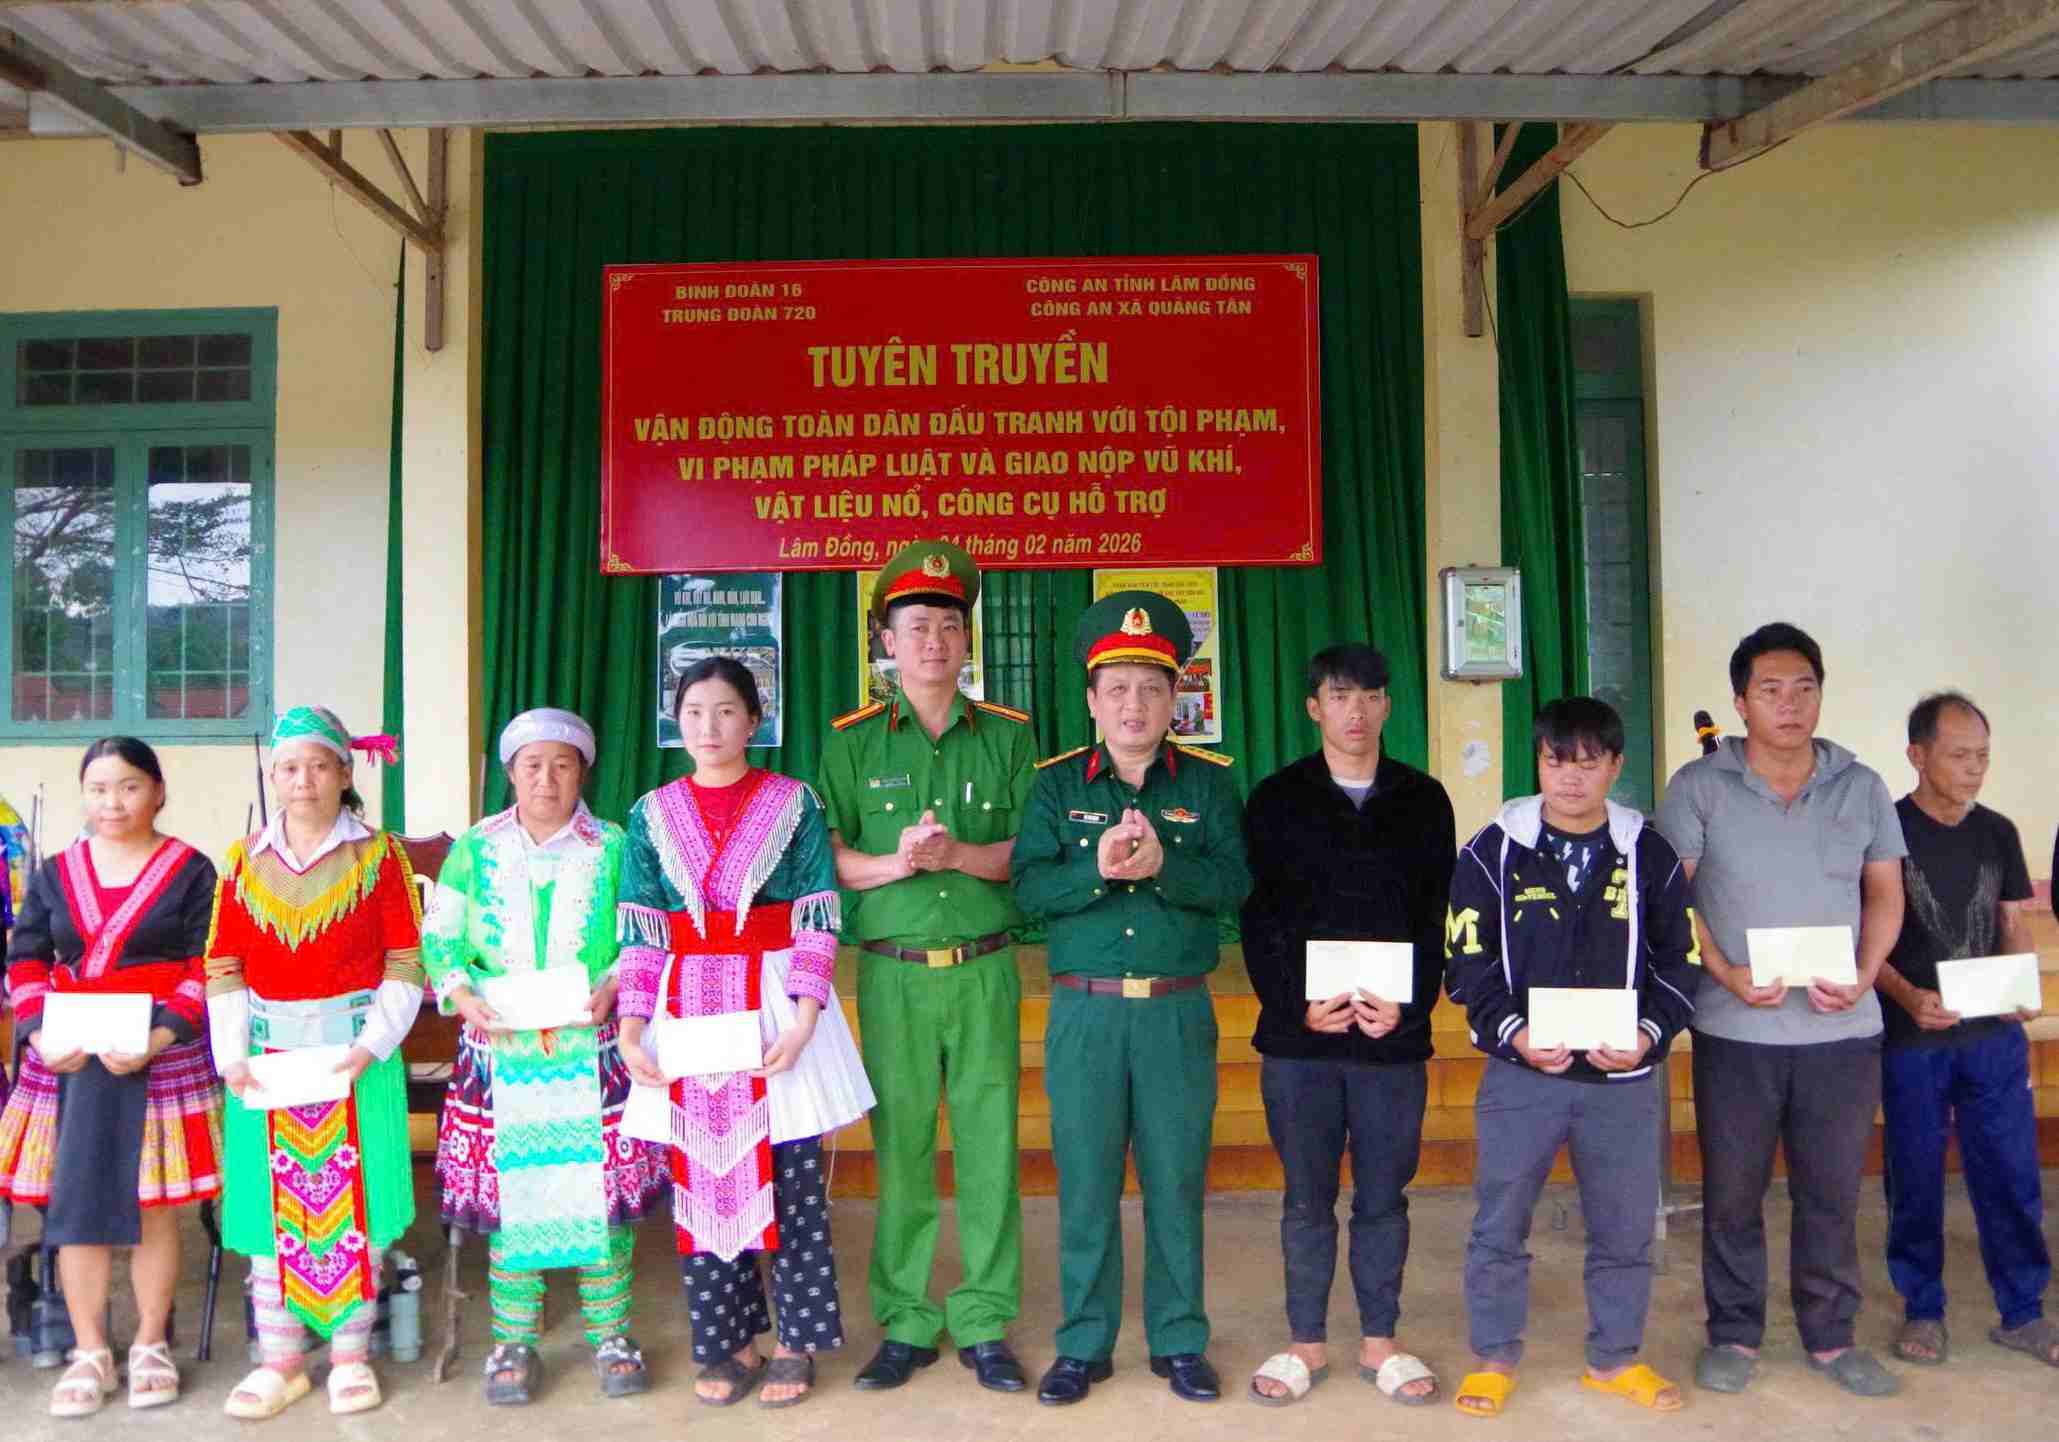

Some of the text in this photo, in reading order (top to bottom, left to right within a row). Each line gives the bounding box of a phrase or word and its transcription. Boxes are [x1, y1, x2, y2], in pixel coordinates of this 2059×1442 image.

[781, 284, 802, 297] 16
[1027, 275, 1076, 292] CÔNG
[1082, 278, 1108, 292] AN
[1161, 275, 1200, 291] LÂM
[663, 308, 720, 323] TRUNG
[783, 306, 816, 320] 720
[1031, 299, 1080, 316] CÔNG
[1087, 301, 1113, 315] AN
[1216, 299, 1252, 315] TÂN
[807, 328, 1109, 388] TUYÊN TRUYỀN
[634, 404, 1286, 445] VẬN ĐỘNG TOÀN DÂN ĐẤU TRANH VỚI TỘI PHẠM,
[679, 444, 1243, 484] VI PHẠM PHÁP LUẬT VÀ GIAO NỘP VŨ KHÍ,
[754, 482, 1167, 525] VẬT LIỆU NỔ, CÔNG CỤ HỖ TRỢ
[779, 537, 819, 558] Lâm
[825, 534, 879, 562] Đồng,
[966, 532, 1019, 561] tháng
[1025, 534, 1047, 555] 02
[1052, 533, 1093, 554] năm
[1097, 532, 1142, 553] 2026
